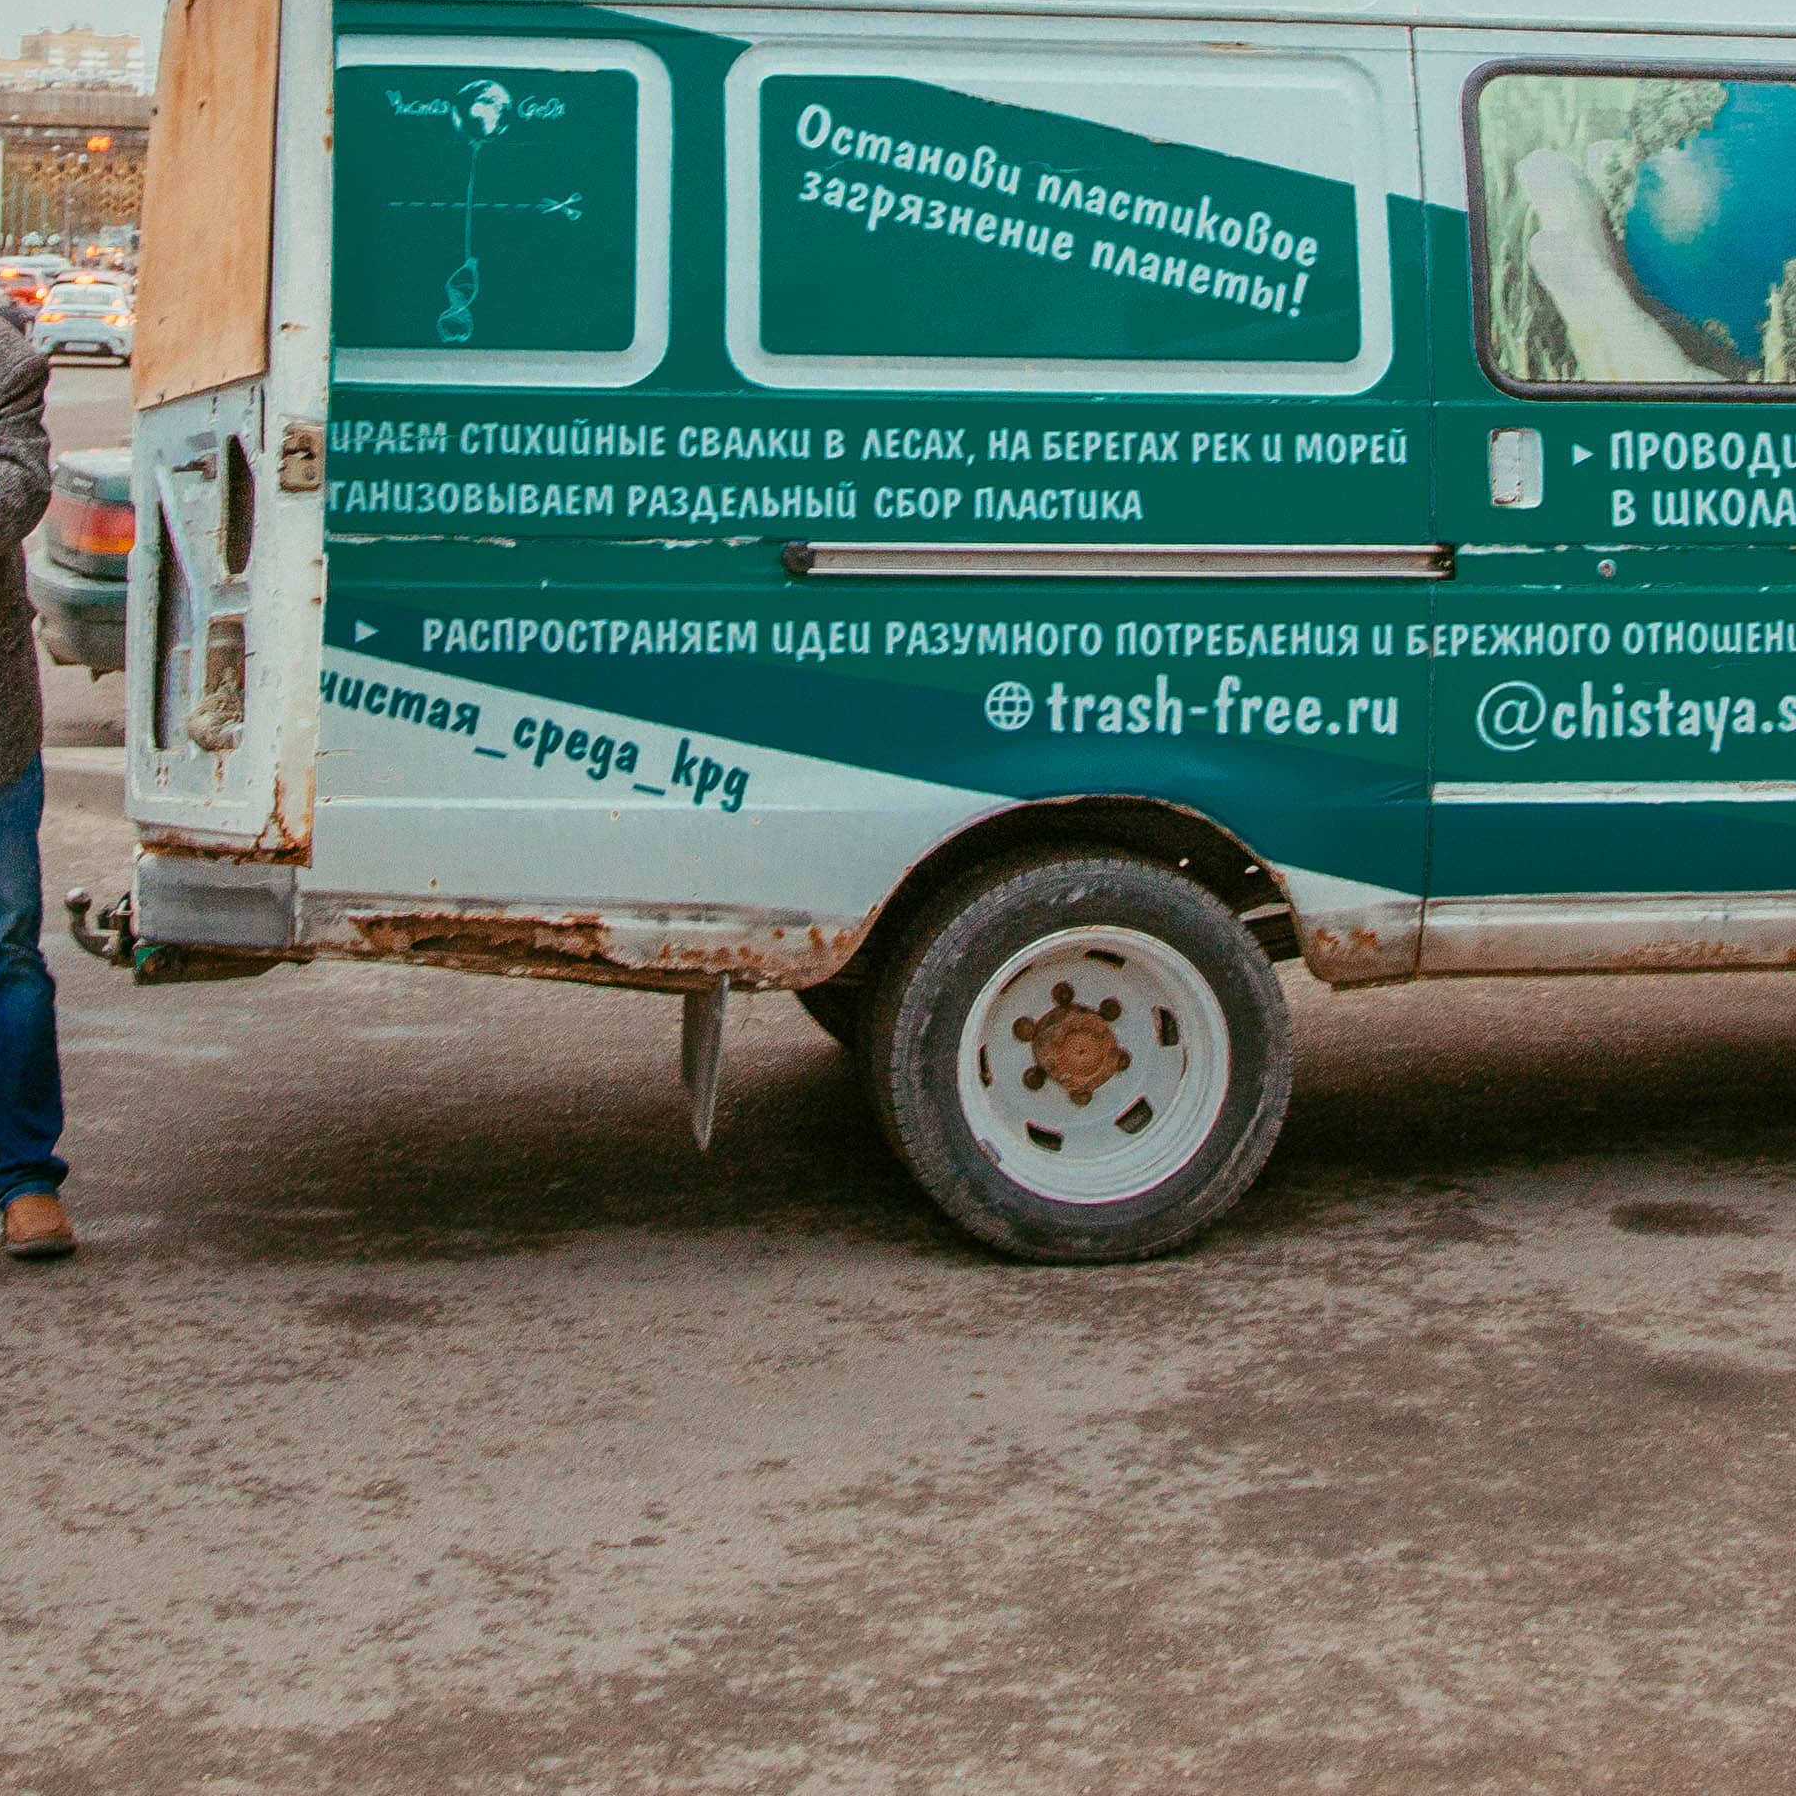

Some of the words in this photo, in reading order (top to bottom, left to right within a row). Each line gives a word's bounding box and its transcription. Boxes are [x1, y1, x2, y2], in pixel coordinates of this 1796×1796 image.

[797, 103, 1019, 197] Останови
[1036, 174, 1320, 270] пластиковое
[798, 169, 1075, 261] загрязнение
[1091, 240, 1310, 319] планеты!
[330, 420, 448, 455] ИРАЕМ
[461, 416, 665, 457] СТИХИЙНЫЕ
[679, 425, 810, 460] СВАЛКИ
[825, 427, 845, 460] В
[862, 428, 976, 468] ЛЕСАХ,
[988, 428, 1030, 462] НА
[1043, 430, 1179, 463] БЕРЕГАХ
[1192, 432, 1250, 463] РЕК
[1262, 433, 1282, 462] И
[1295, 426, 1407, 464] МОРЕЙ
[327, 479, 614, 517] ГАНИЗОВЫВАЕМ
[627, 478, 857, 523] РАЗДЕЛЬНЫЙ
[874, 487, 962, 519] СБОР
[974, 486, 1143, 520] ПЛАСТИКА
[1612, 488, 1636, 528] В
[422, 617, 758, 655] РАСПРОСТРАНЯЕМ
[772, 621, 870, 661] ИДЕИ
[886, 621, 1103, 657] РАЗУМНОГО
[1116, 621, 1359, 658] ПОТРЕБЛЕНИЯ
[1372, 624, 1393, 656] И
[1406, 622, 1611, 657] БЕРЕЖНОГО
[1046, 674, 1400, 737] trash-free.ru
[319, 668, 751, 814] чистая_среда_крд
